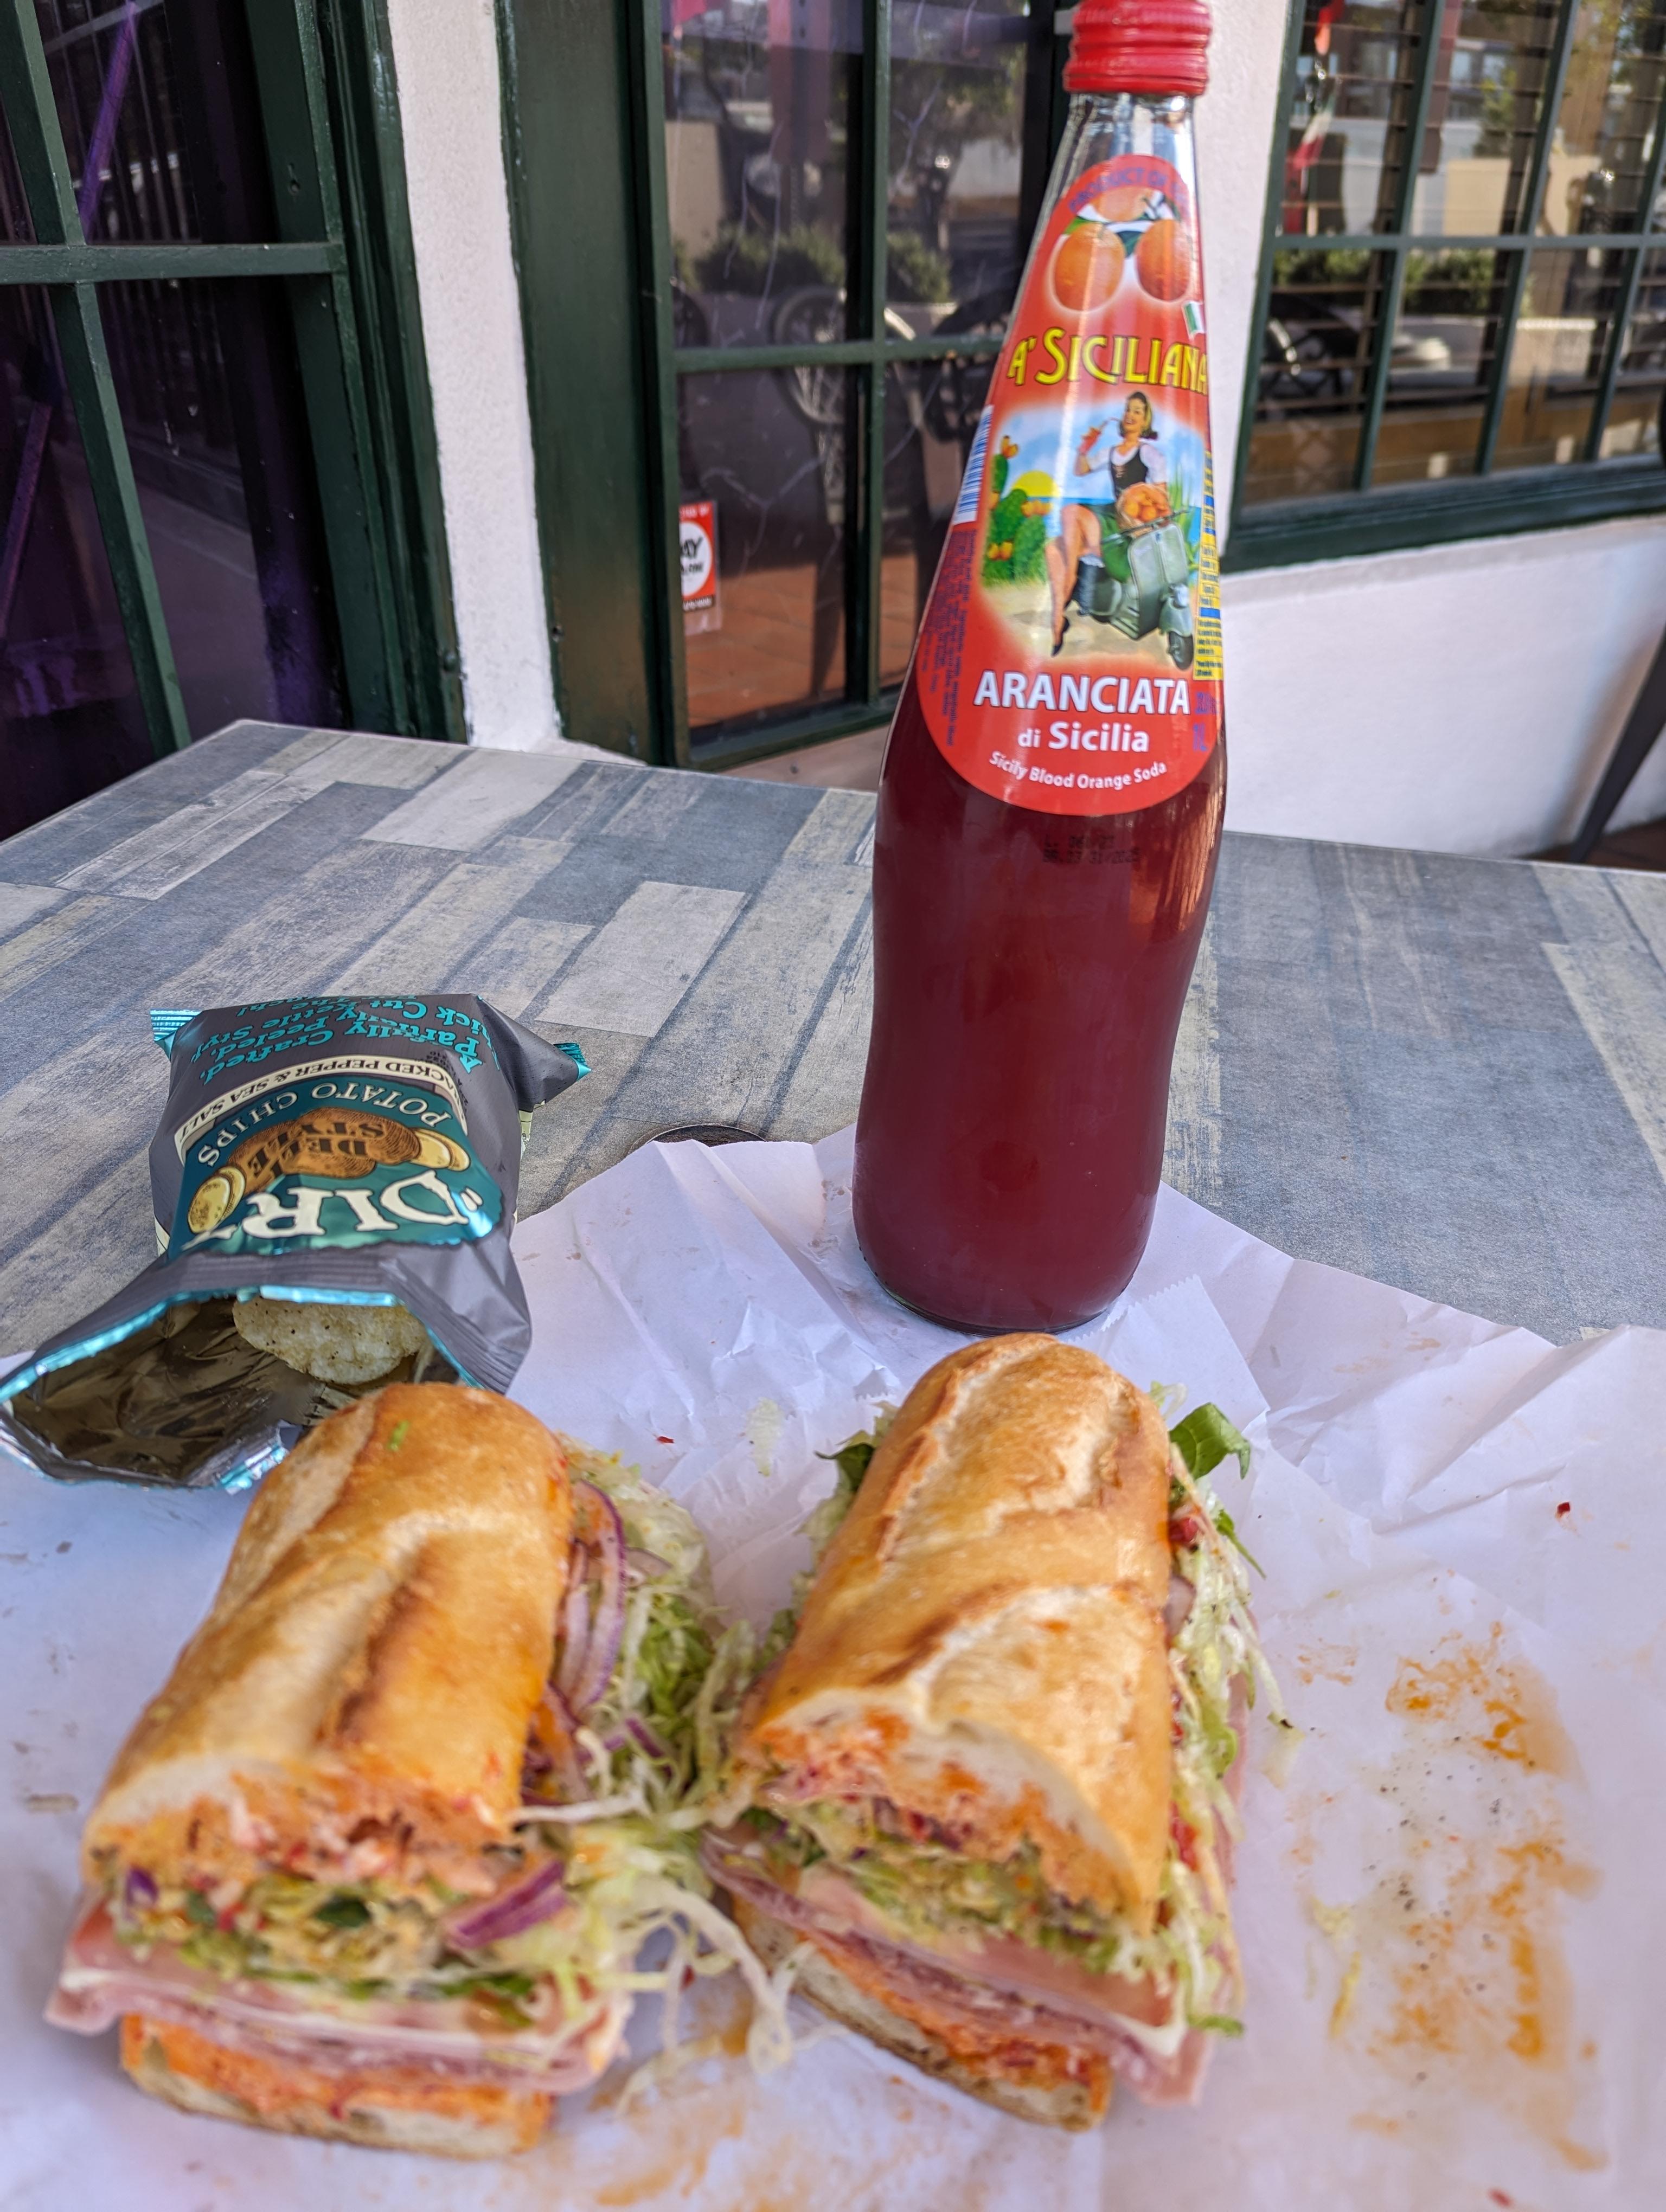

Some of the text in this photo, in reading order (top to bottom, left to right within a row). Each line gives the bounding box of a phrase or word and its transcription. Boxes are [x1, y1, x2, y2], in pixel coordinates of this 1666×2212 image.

[1034, 326, 1208, 396] SICILIANA
[973, 669, 1191, 715] ARANCIATA
[1017, 720, 1150, 753] di Sicilia
[989, 750, 1168, 791] Sicily Blood Orange Soda
[262, 1001, 360, 1028] Kettle
[369, 999, 427, 1019] Cut
[200, 1030, 334, 1085] Crafted,
[210, 1015, 329, 1063] Peeled,
[273, 1071, 291, 1083] &
[295, 1059, 380, 1077] PEPPER
[230, 1078, 269, 1103] SEA
[311, 1081, 452, 1128] POTATO
[180, 1099, 225, 1142] SALT
[197, 1091, 298, 1167] CHIPS
